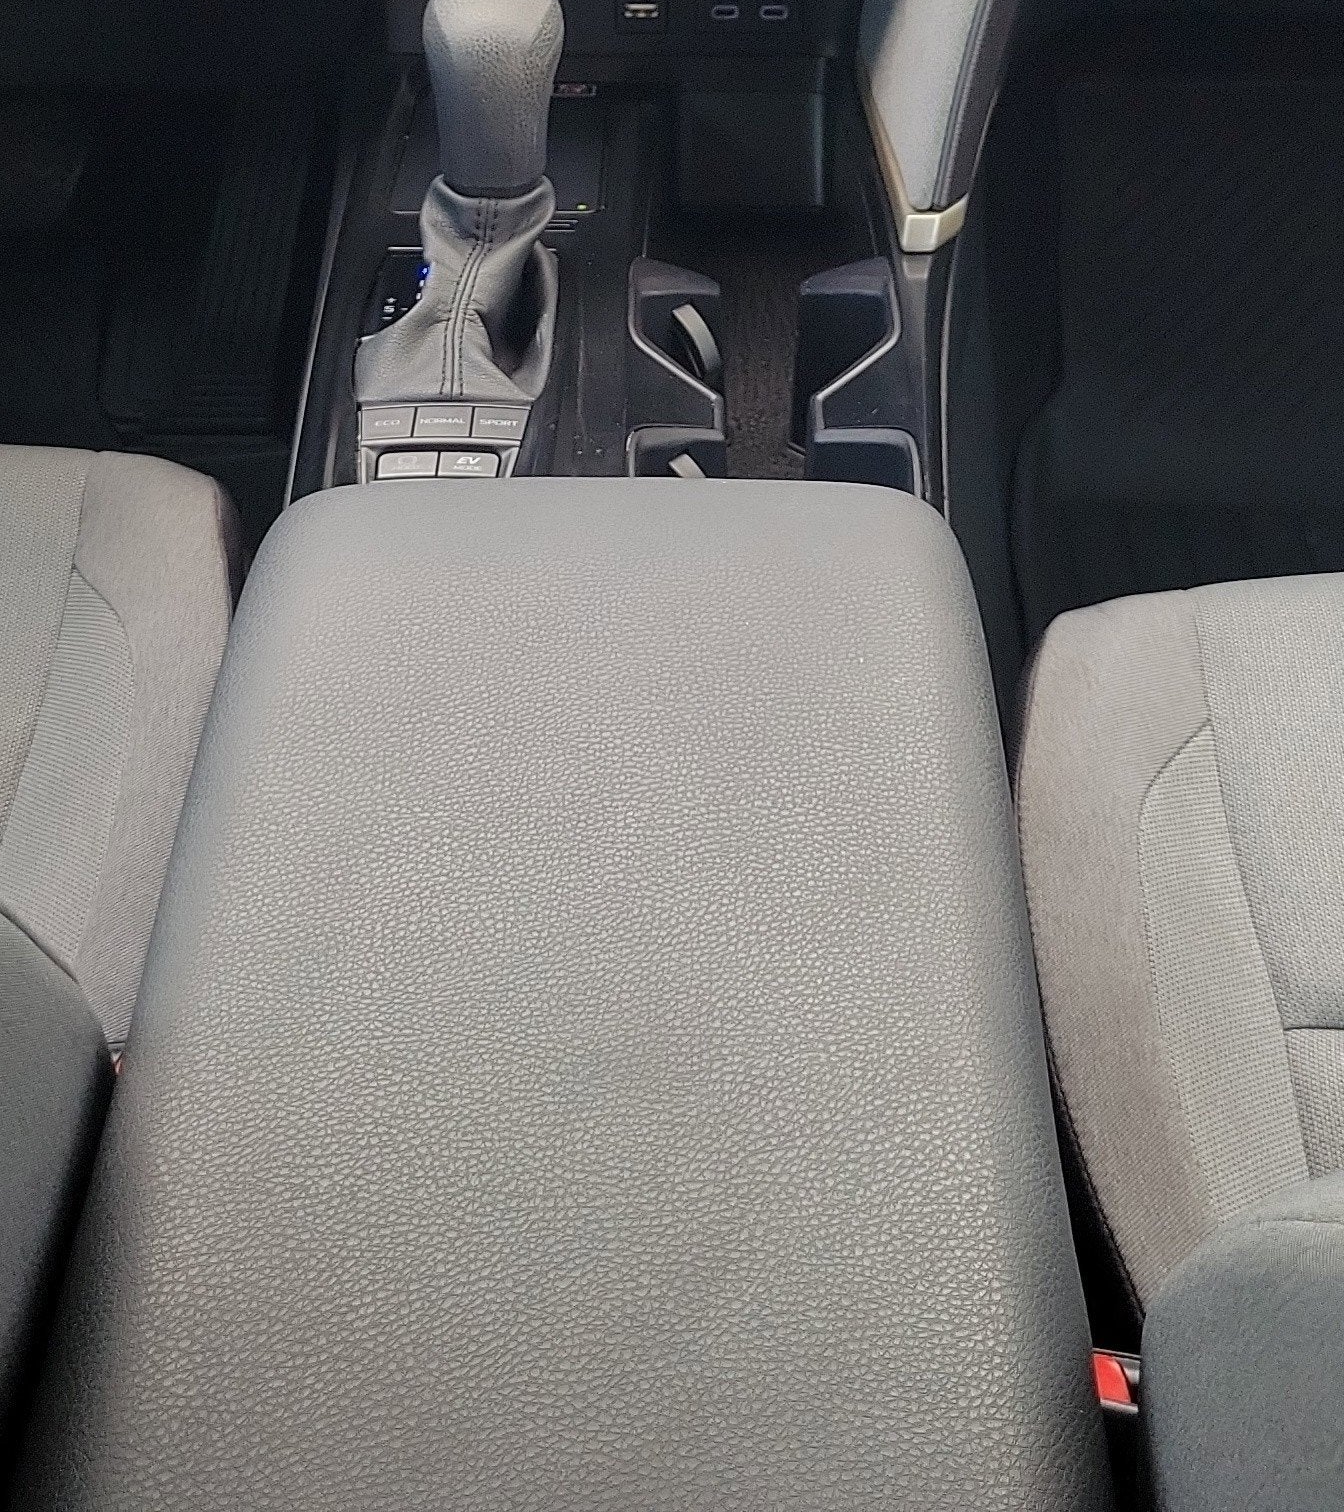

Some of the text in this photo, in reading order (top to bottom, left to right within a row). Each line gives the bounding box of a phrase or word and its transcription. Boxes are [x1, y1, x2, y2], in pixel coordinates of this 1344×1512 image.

[375, 419, 401, 428] ECO
[419, 417, 466, 426] NORMAL
[479, 418, 519, 428] SPORT
[456, 455, 482, 466] EV
